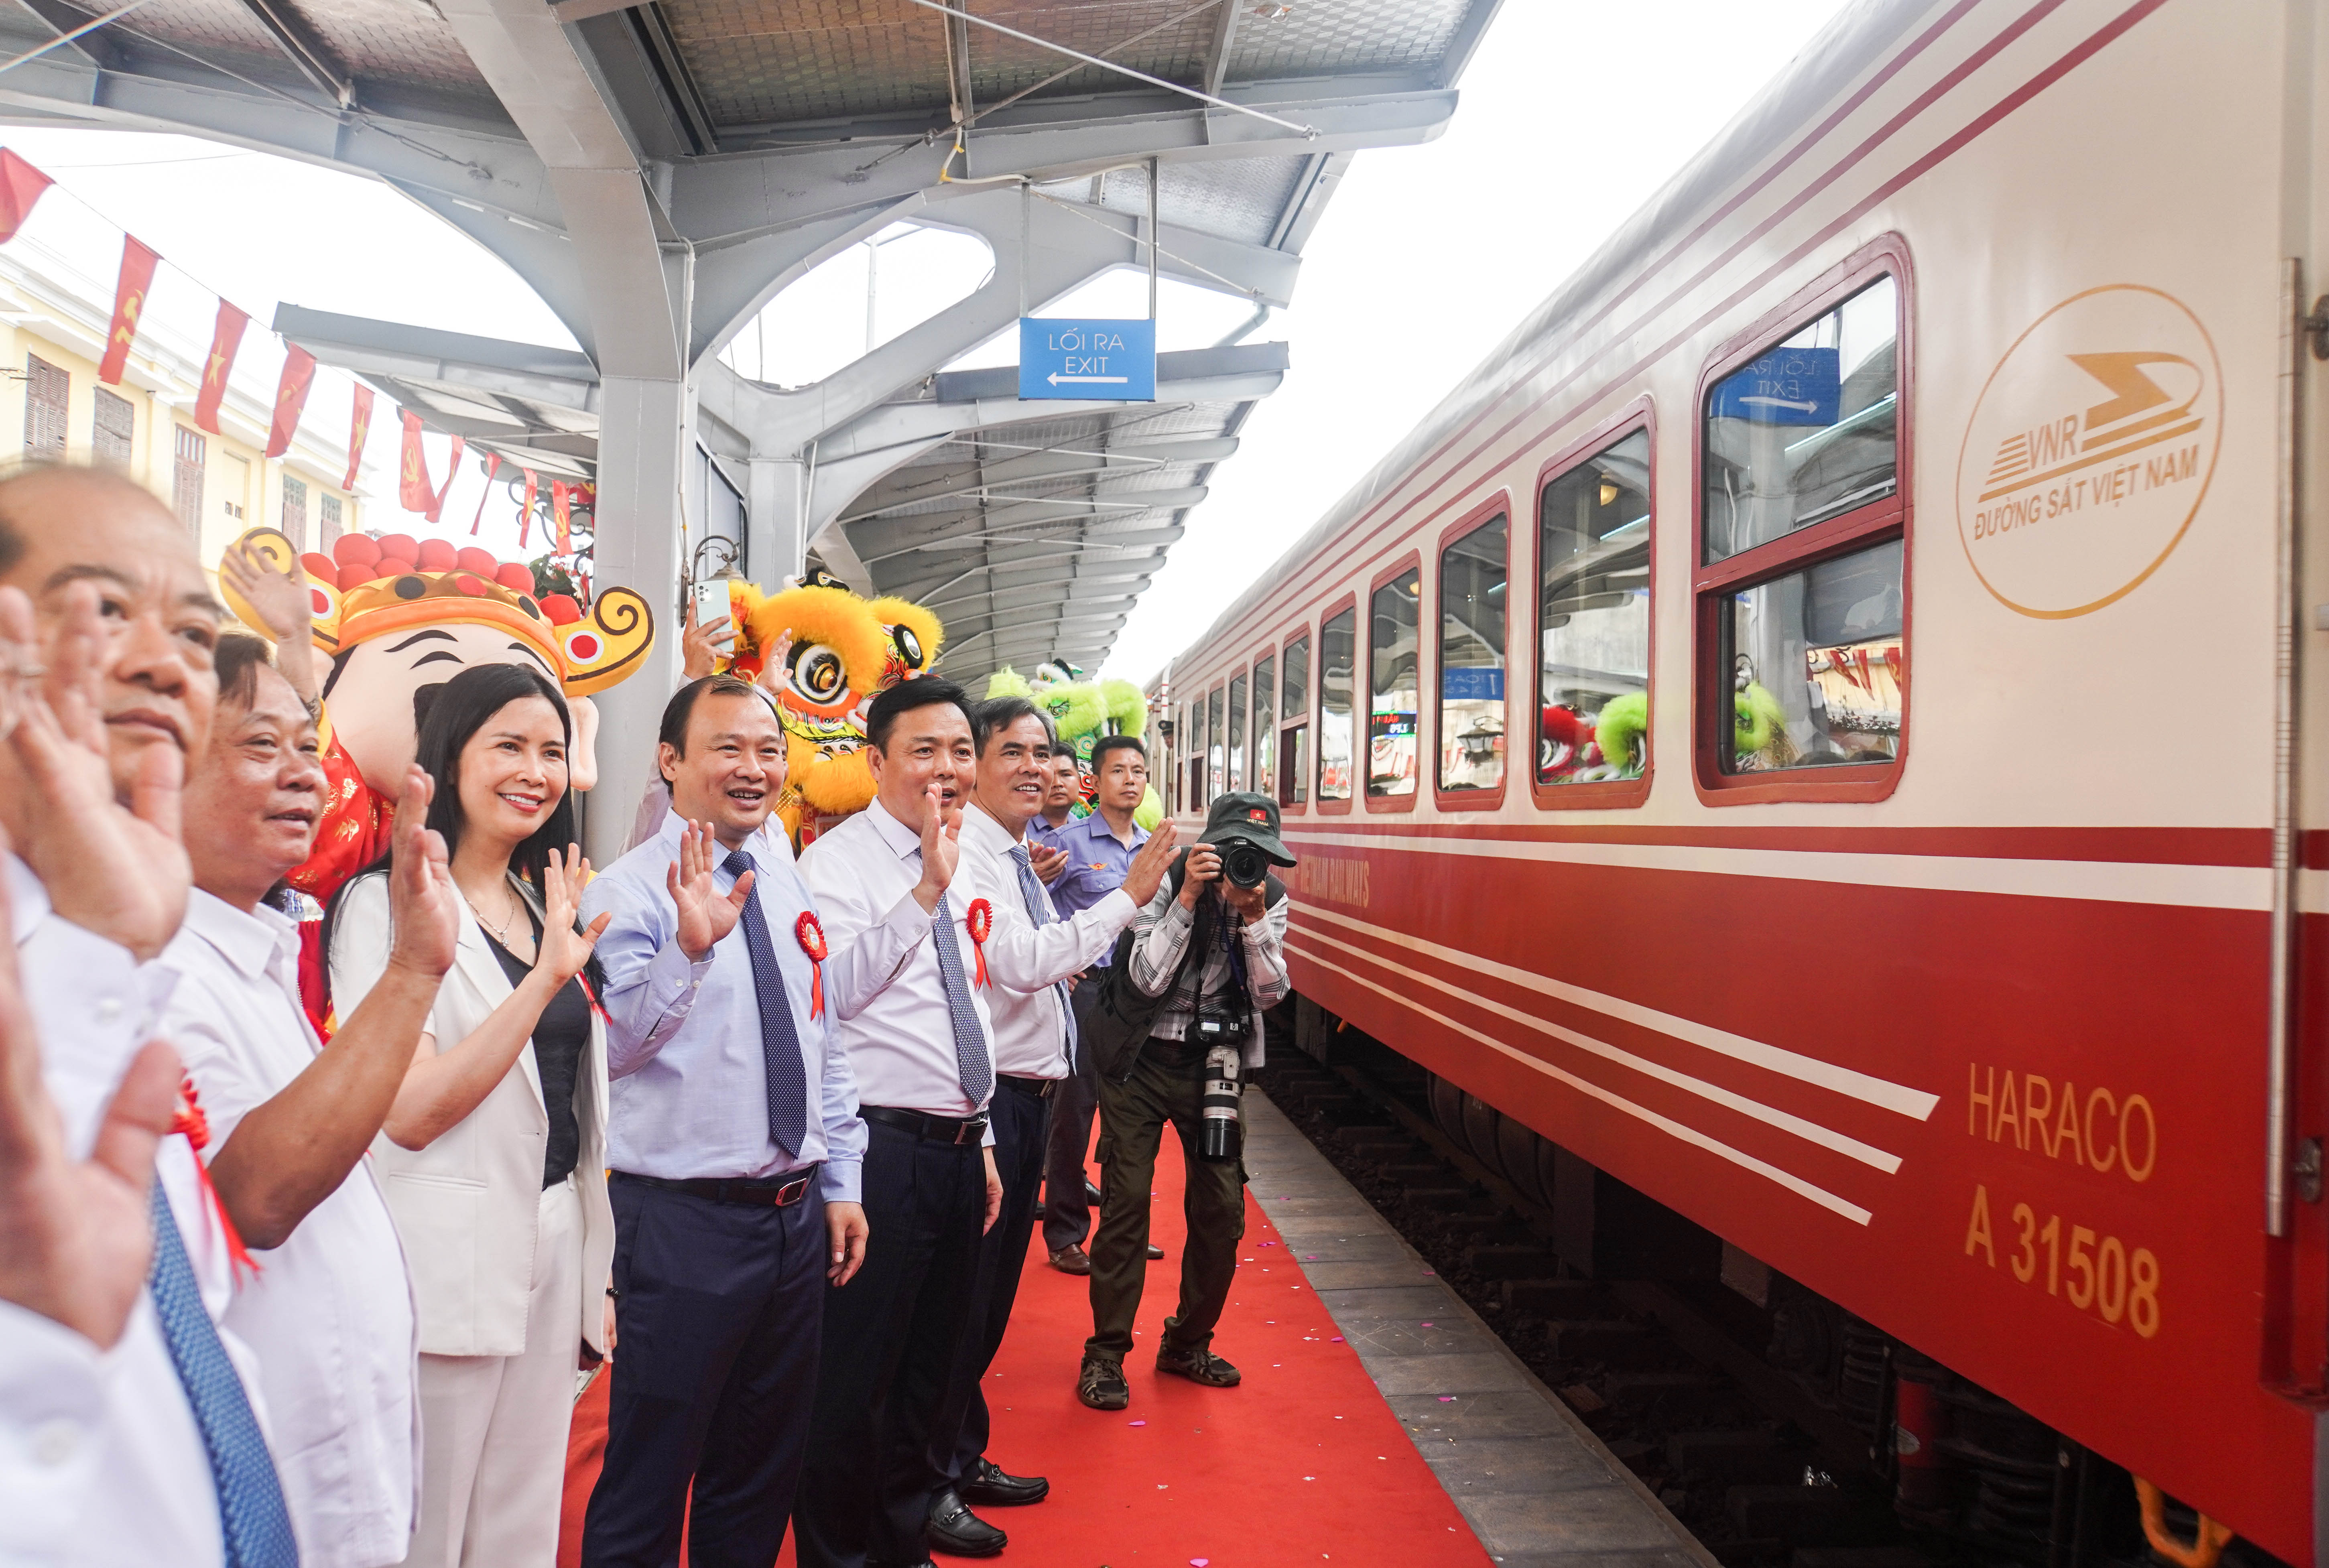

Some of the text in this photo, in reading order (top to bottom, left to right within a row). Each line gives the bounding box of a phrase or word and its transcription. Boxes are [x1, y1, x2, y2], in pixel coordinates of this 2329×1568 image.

[1049, 327, 1124, 351] LỐI RA
[1066, 356, 1108, 374] EXIT
[2028, 414, 2078, 469] VNR
[1974, 496, 2042, 540] ĐƯỜNG
[2092, 463, 2140, 508] VIỆT
[2144, 443, 2199, 491] NAM
[1329, 857, 1369, 908] RAILWAYS
[1969, 1062, 2157, 1183] HARACO
[1965, 1183, 2160, 1339] A 31508
